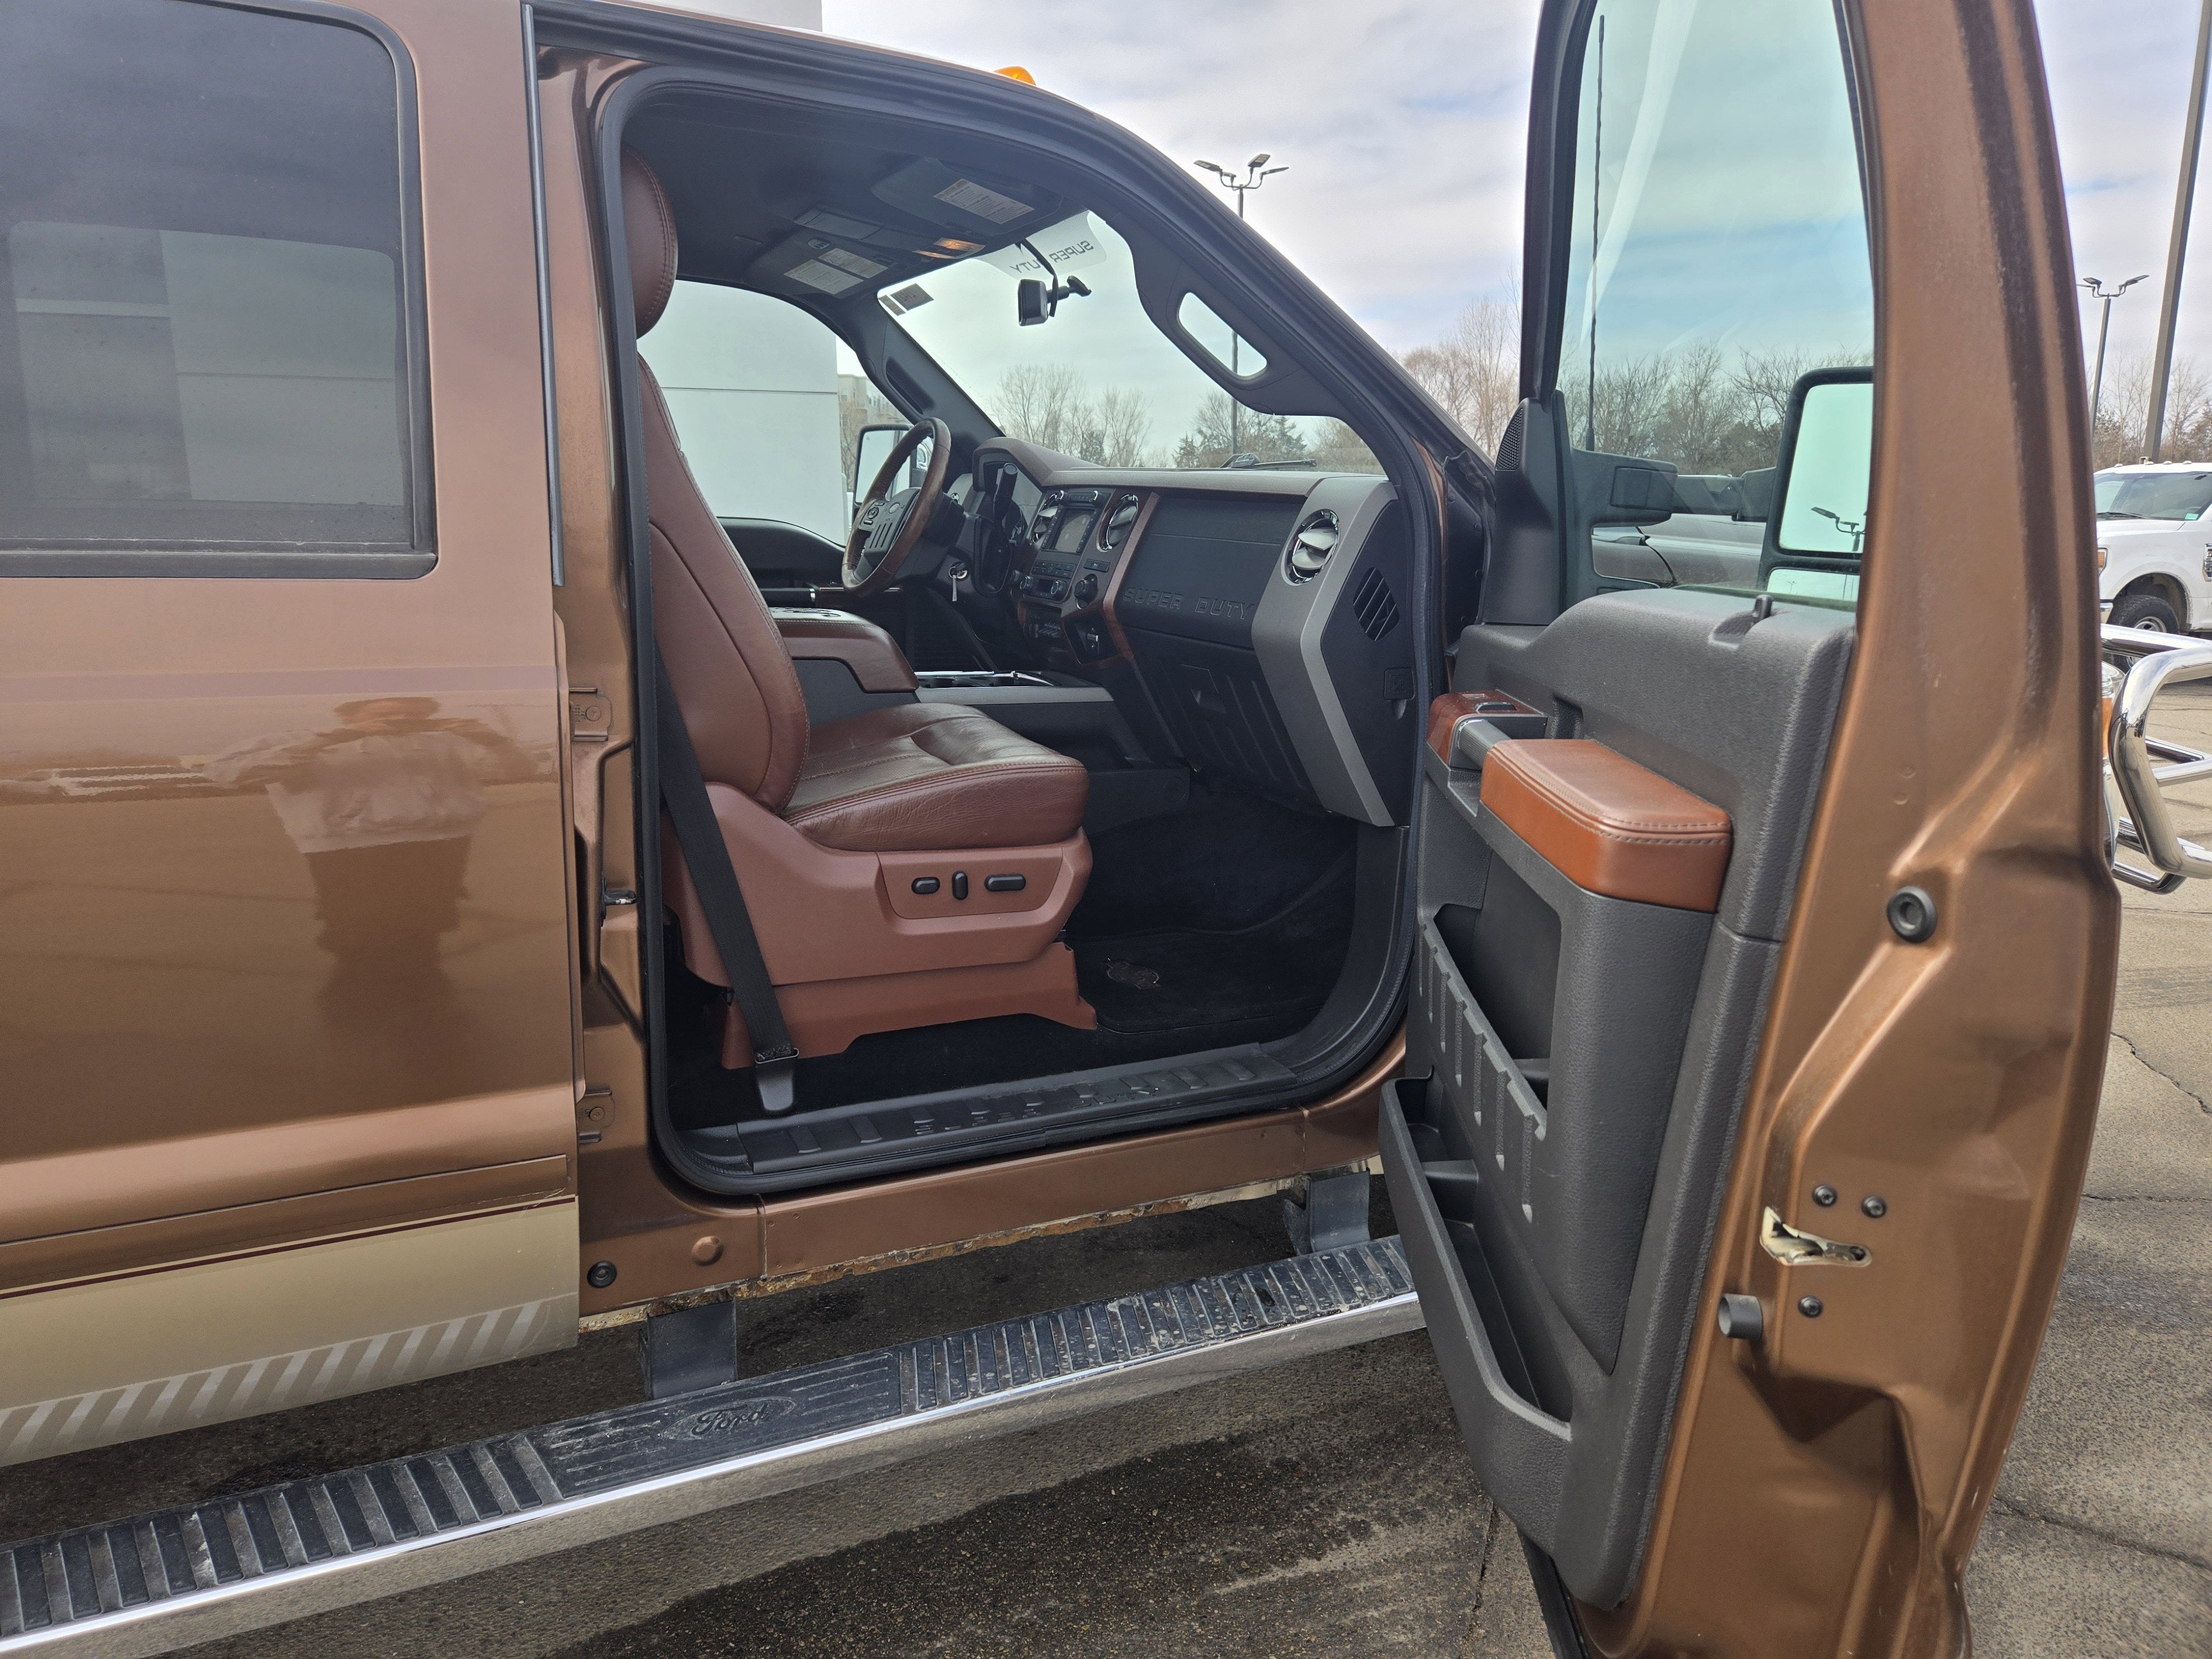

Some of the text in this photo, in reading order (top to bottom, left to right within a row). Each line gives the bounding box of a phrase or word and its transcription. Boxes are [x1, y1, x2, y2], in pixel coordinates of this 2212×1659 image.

[1123, 586, 1255, 620] SUPER DUTY
[691, 1403, 770, 1436] Ford
